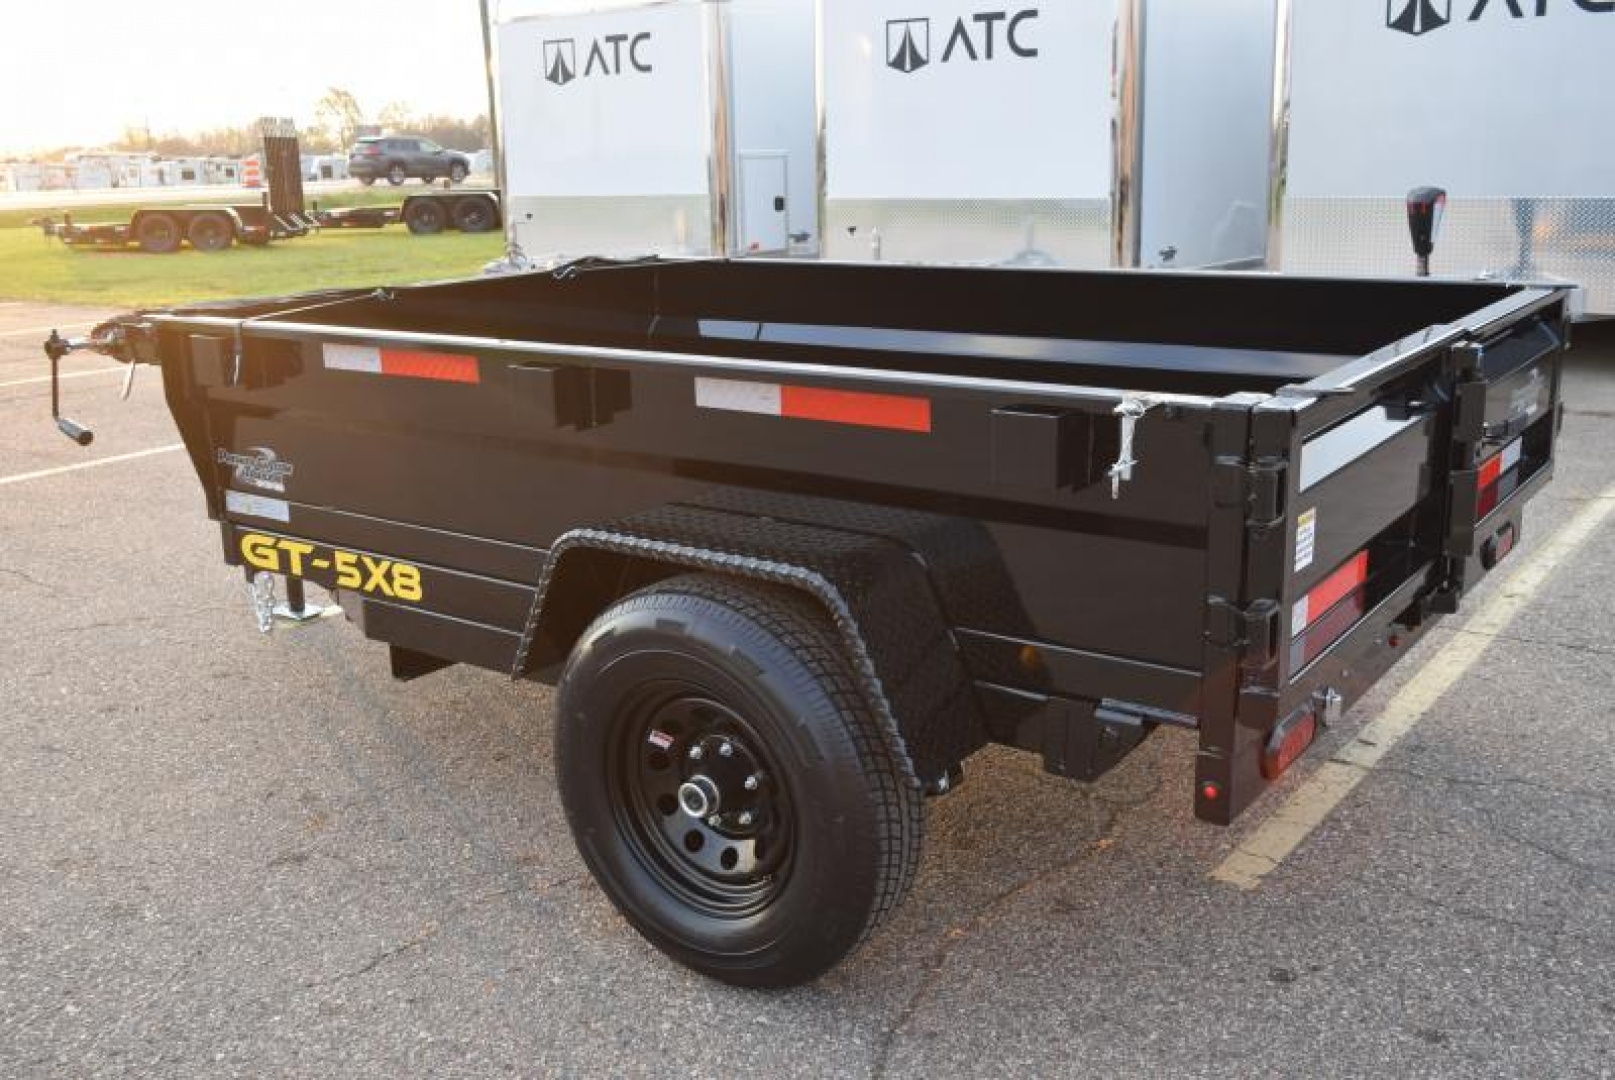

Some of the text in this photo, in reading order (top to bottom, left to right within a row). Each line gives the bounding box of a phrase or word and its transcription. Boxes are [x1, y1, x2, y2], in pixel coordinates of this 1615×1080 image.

[585, 32, 652, 76] ATC
[943, 10, 1038, 61] ATC
[241, 533, 422, 601] GT-5X8
